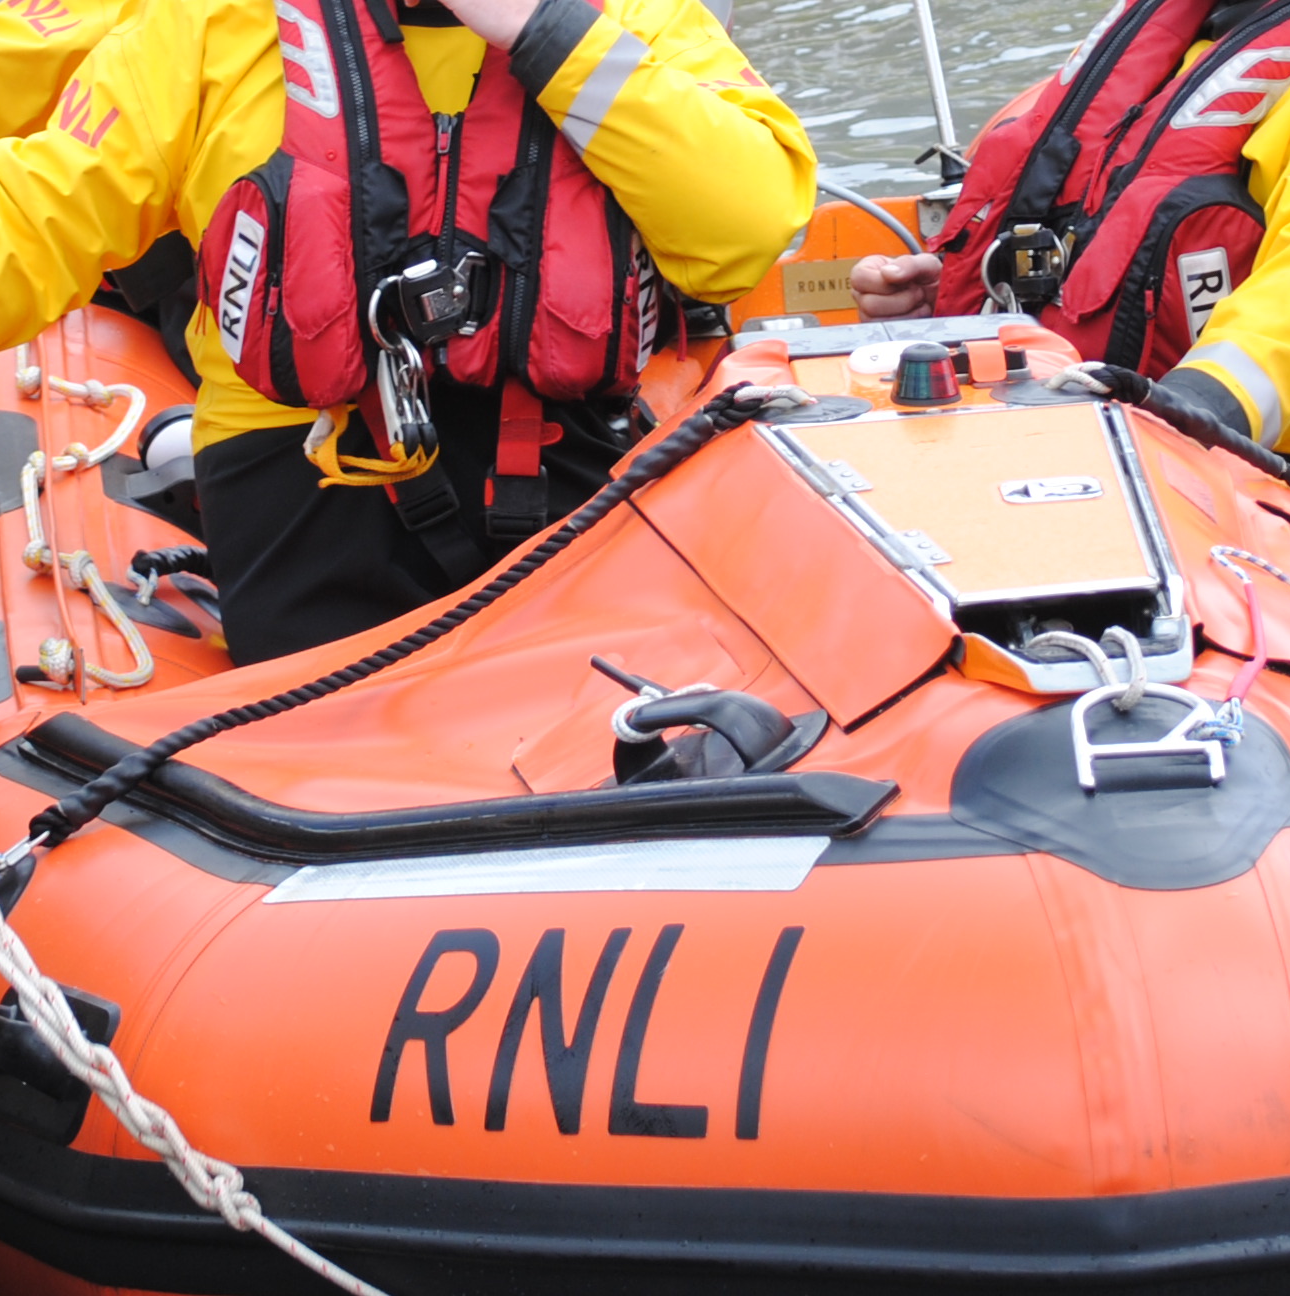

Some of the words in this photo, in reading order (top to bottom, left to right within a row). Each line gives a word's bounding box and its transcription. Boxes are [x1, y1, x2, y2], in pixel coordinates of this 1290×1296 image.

[222, 232, 259, 341] RNLI
[798, 277, 852, 292] RONNIE
[370, 923, 805, 1140] RNLI
